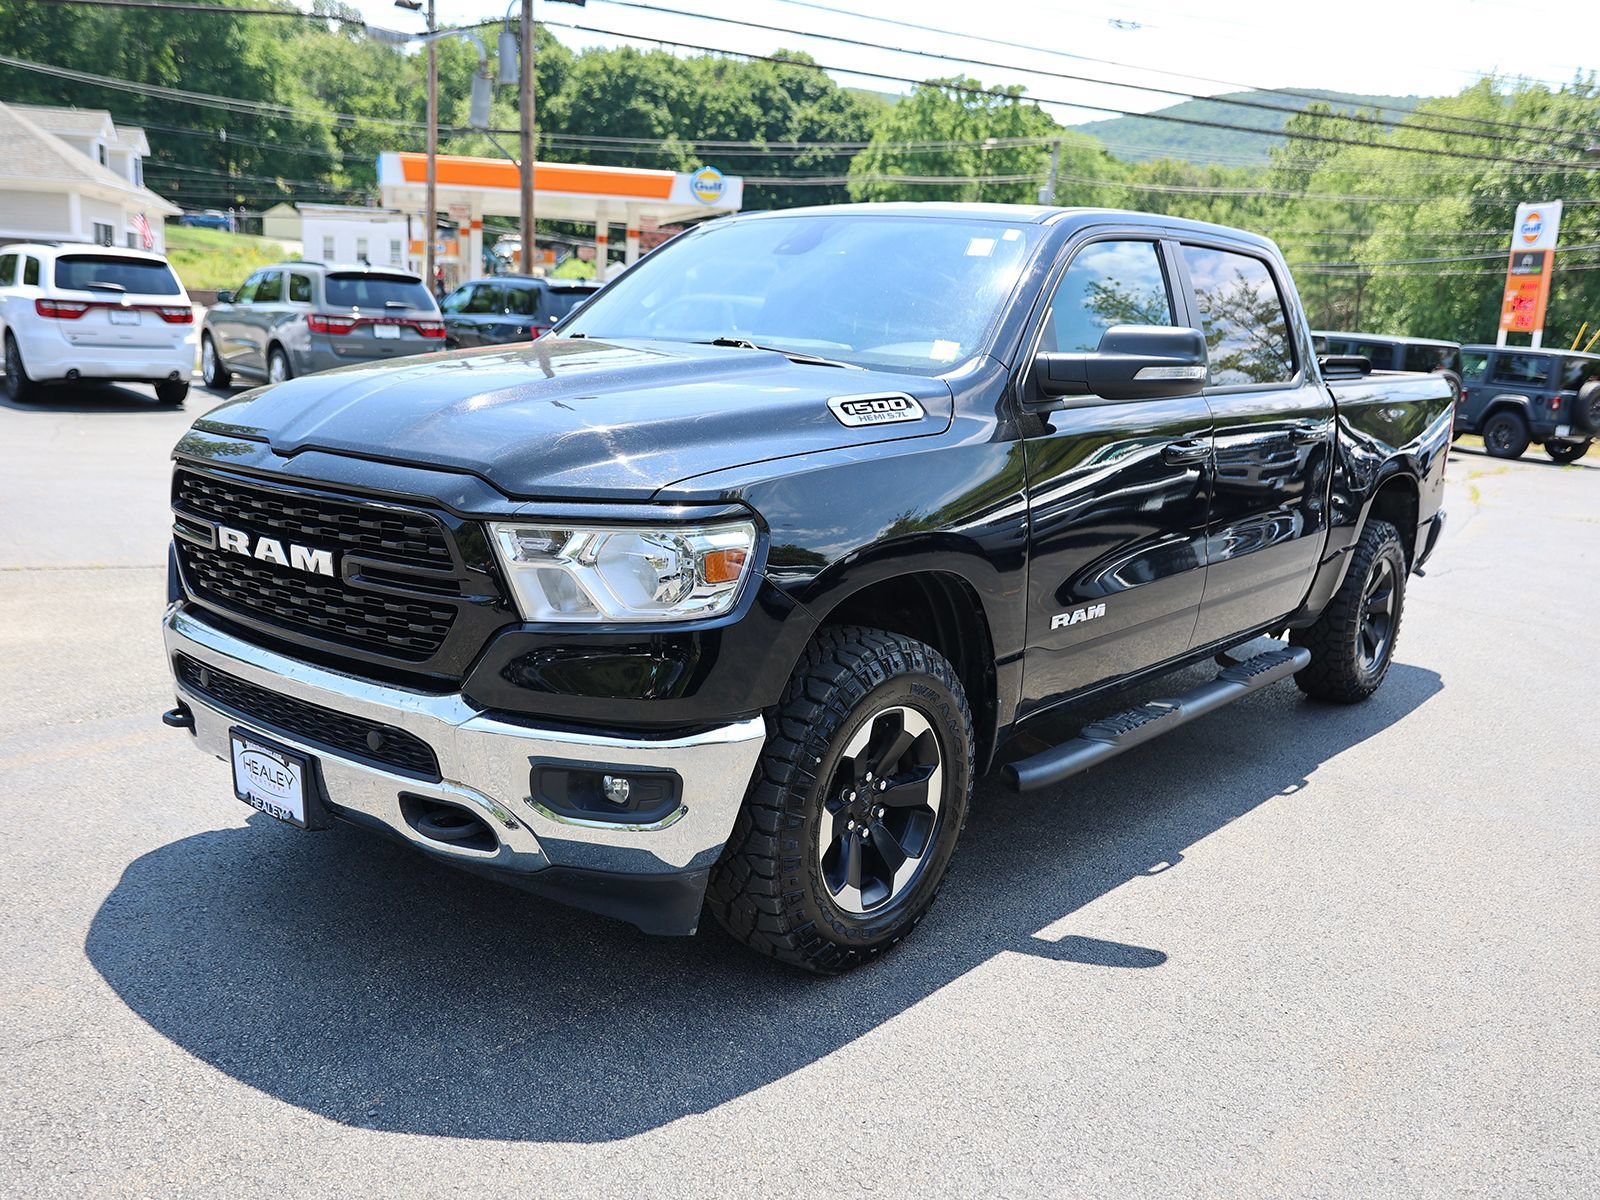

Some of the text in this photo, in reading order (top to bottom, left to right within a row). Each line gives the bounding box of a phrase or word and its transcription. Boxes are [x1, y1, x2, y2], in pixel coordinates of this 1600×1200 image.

[695, 181, 723, 191] Gulf
[1520, 223, 1542, 234] Gulf
[843, 399, 908, 416] 1500
[858, 411, 909, 423] HEMI 5.7L
[218, 525, 334, 577] RAM
[1050, 603, 1106, 630] RAM
[242, 756, 294, 790] HEALEY
